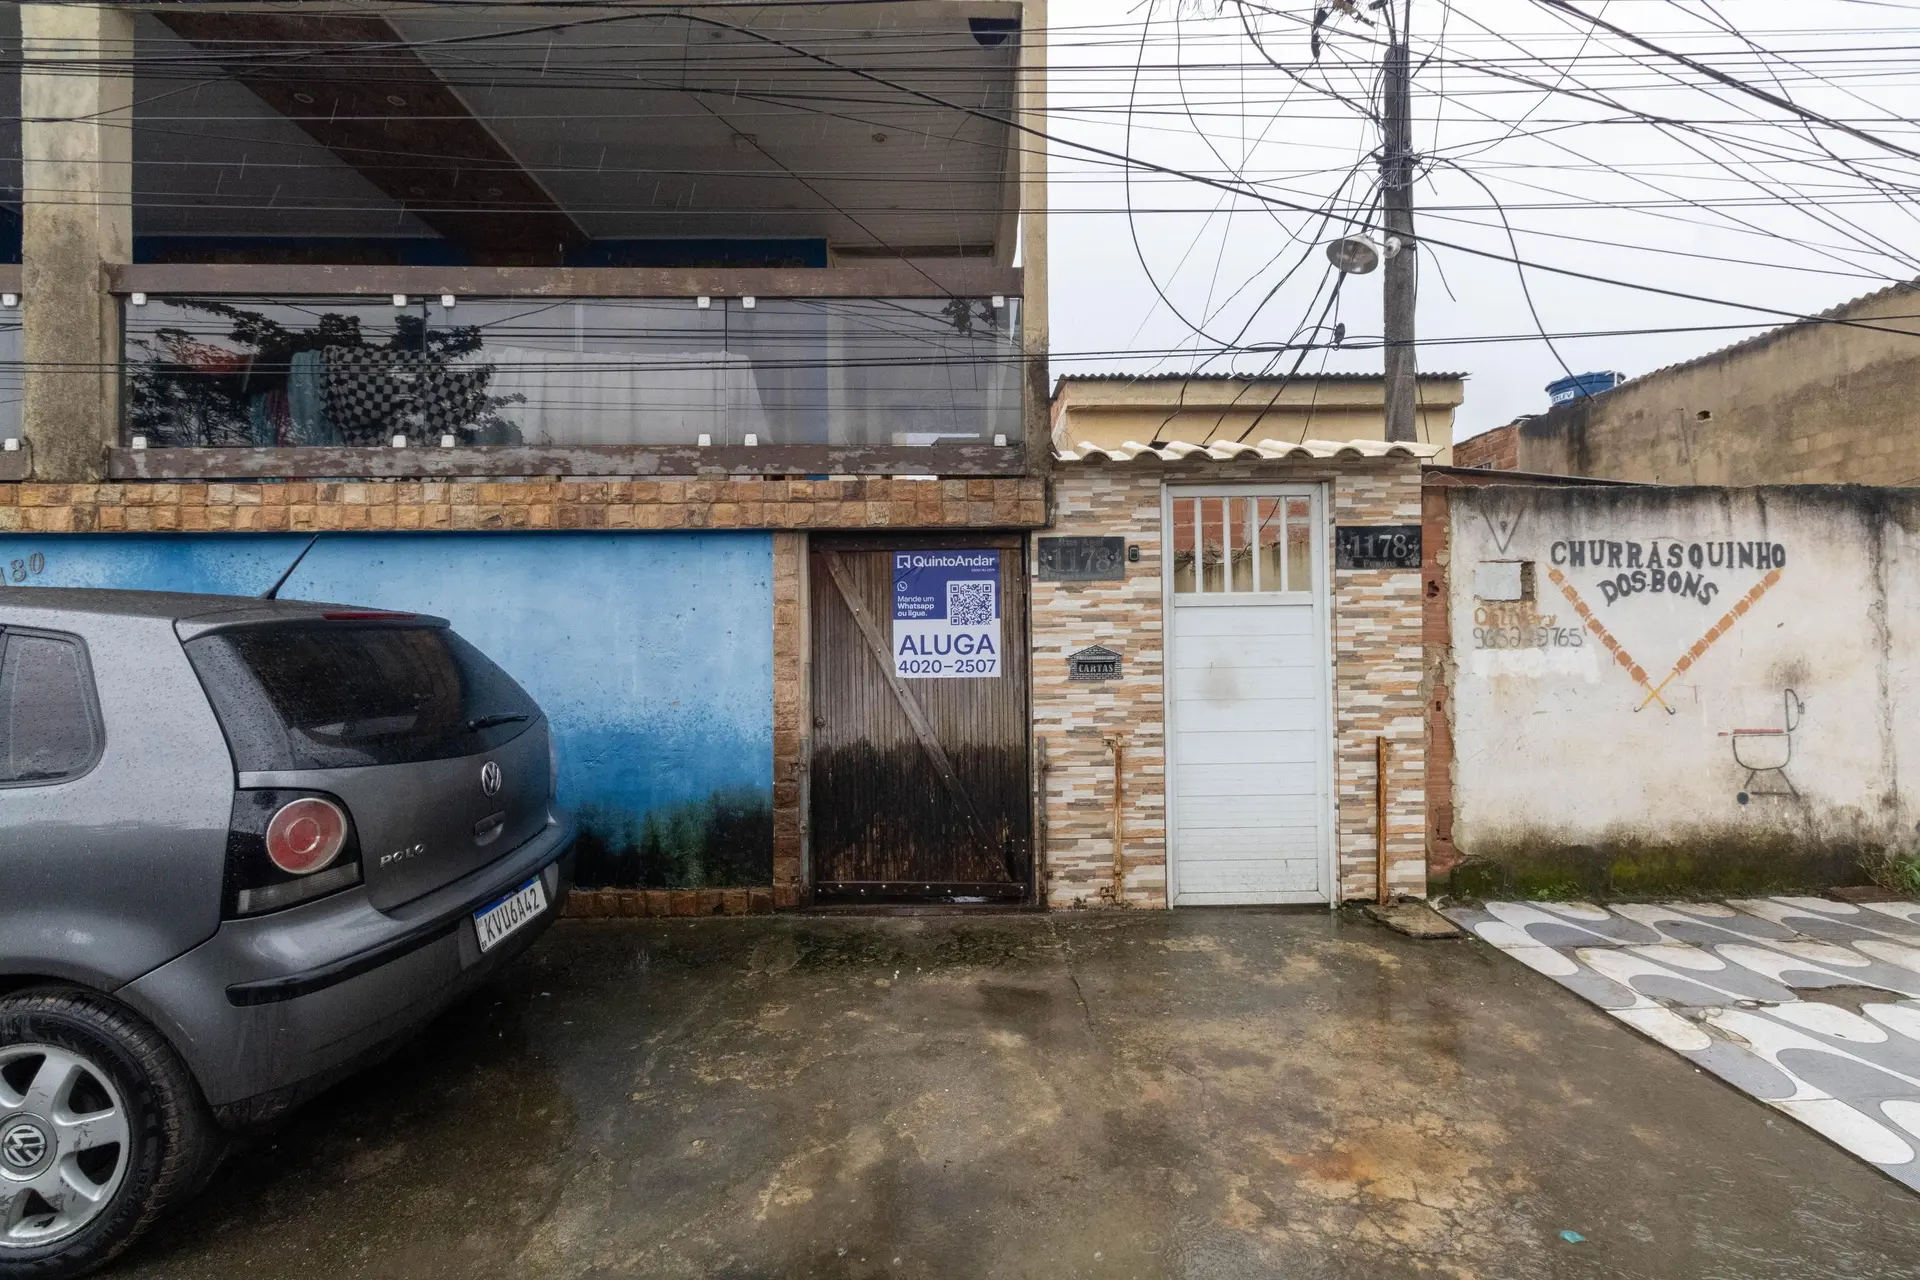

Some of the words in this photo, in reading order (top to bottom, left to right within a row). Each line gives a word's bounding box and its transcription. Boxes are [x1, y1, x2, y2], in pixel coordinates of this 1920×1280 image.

[1350, 533, 1408, 558] 1178
[913, 555, 996, 568] QuintoAndar
[1050, 546, 1112, 573] 1178
[897, 595, 922, 603] Mande
[897, 602, 935, 611] Whatsapp
[907, 609, 928, 619] ligue.
[898, 633, 996, 656] ALUGA
[898, 658, 997, 674] 4020-2507
[1078, 664, 1114, 673] CARTAS
[379, 843, 425, 870] POLO
[483, 887, 540, 943] KVU6A42
